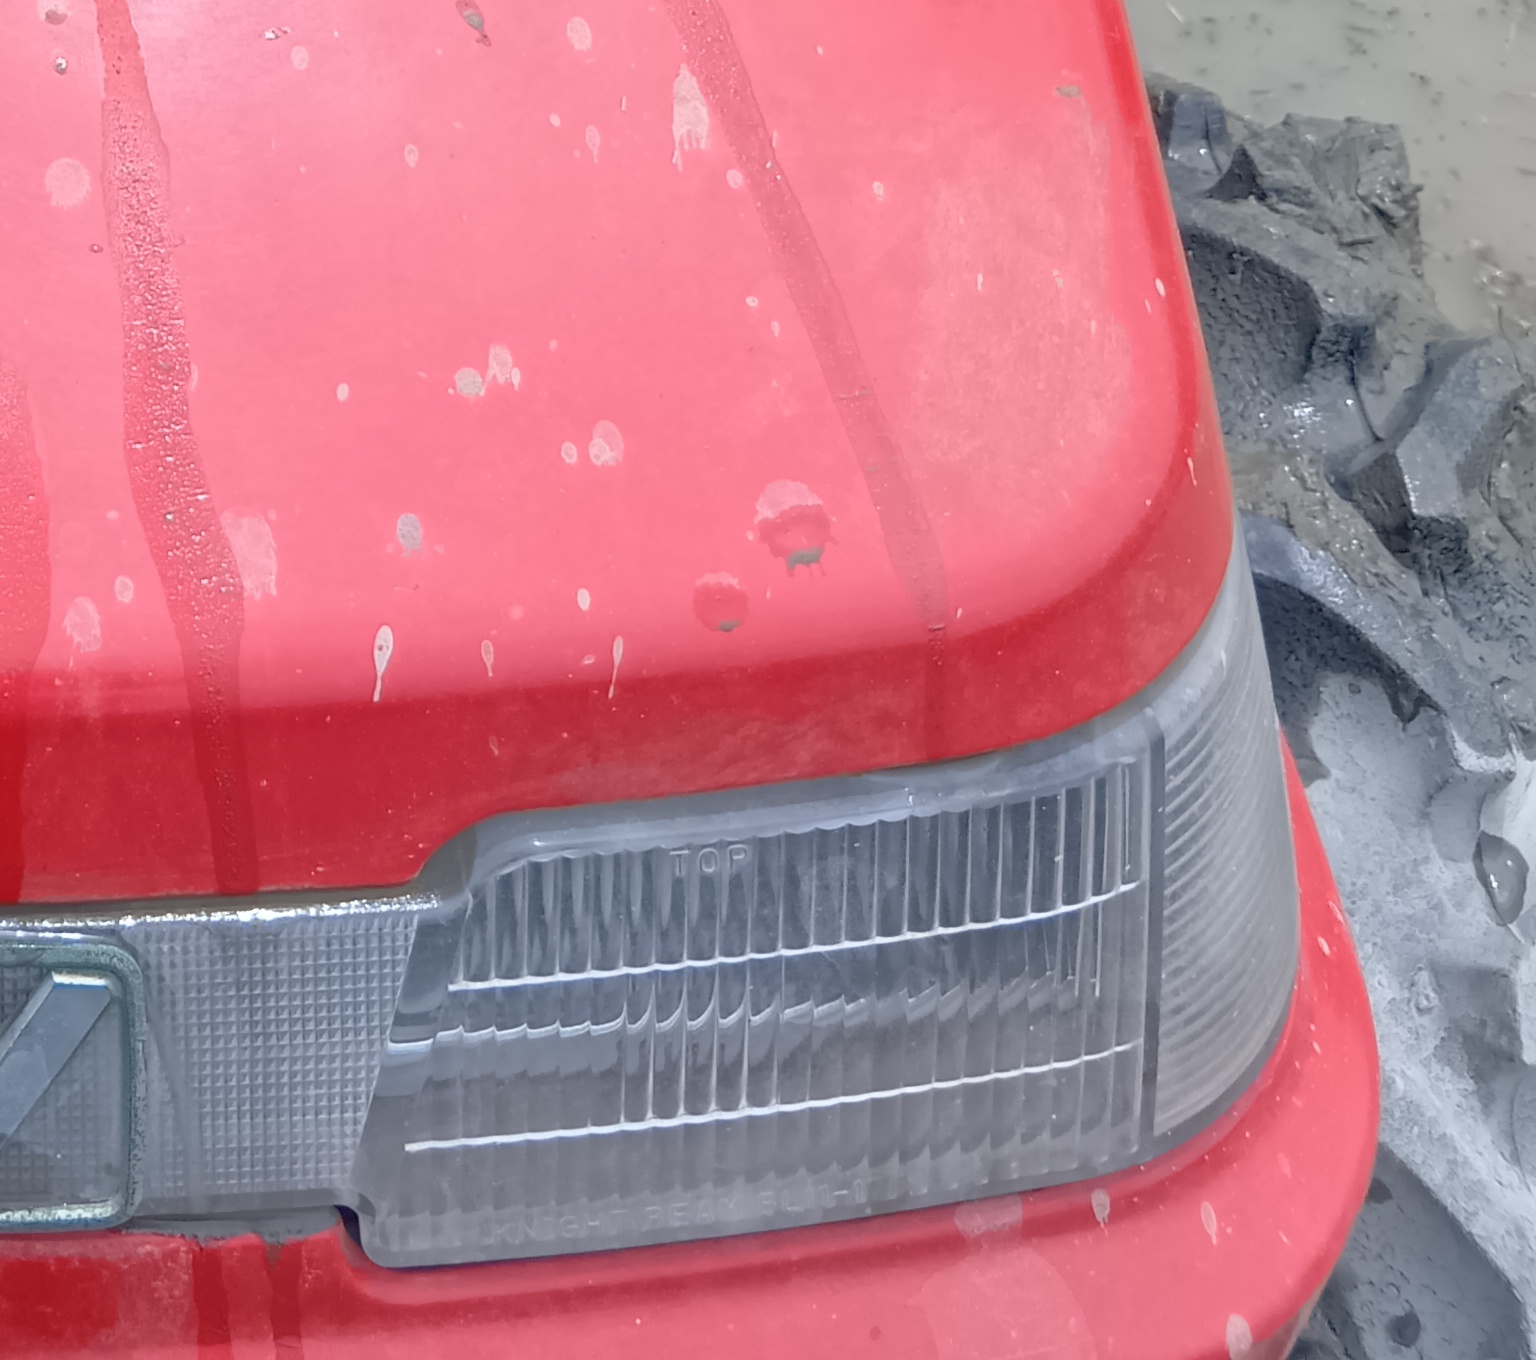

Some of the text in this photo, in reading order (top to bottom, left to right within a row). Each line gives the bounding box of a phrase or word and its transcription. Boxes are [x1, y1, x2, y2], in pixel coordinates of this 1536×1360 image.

[668, 843, 749, 877] TOP
[495, 1208, 629, 1245] KNIGHT
[644, 1196, 740, 1232] BEAM
